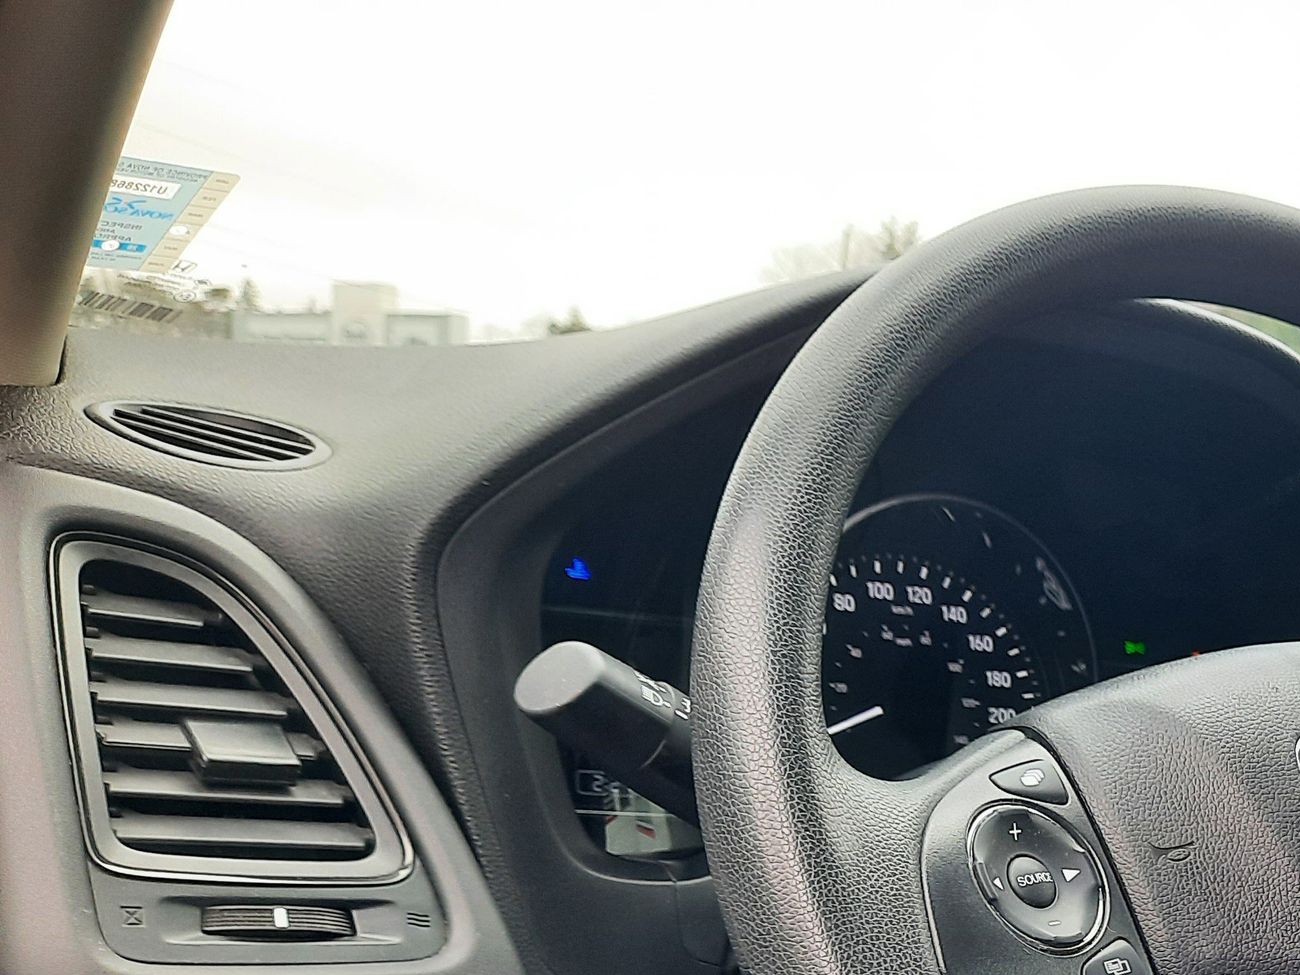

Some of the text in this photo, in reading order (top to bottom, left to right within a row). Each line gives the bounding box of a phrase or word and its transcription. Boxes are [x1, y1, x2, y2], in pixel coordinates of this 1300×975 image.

[866, 581, 894, 601] 100
[906, 586, 933, 605] 120
[832, 592, 856, 612] 80
[940, 605, 968, 624] 140
[967, 634, 994, 653] 160
[985, 670, 1012, 689] 180
[987, 707, 1017, 725] 200
[1017, 871, 1053, 887] SOURCE
